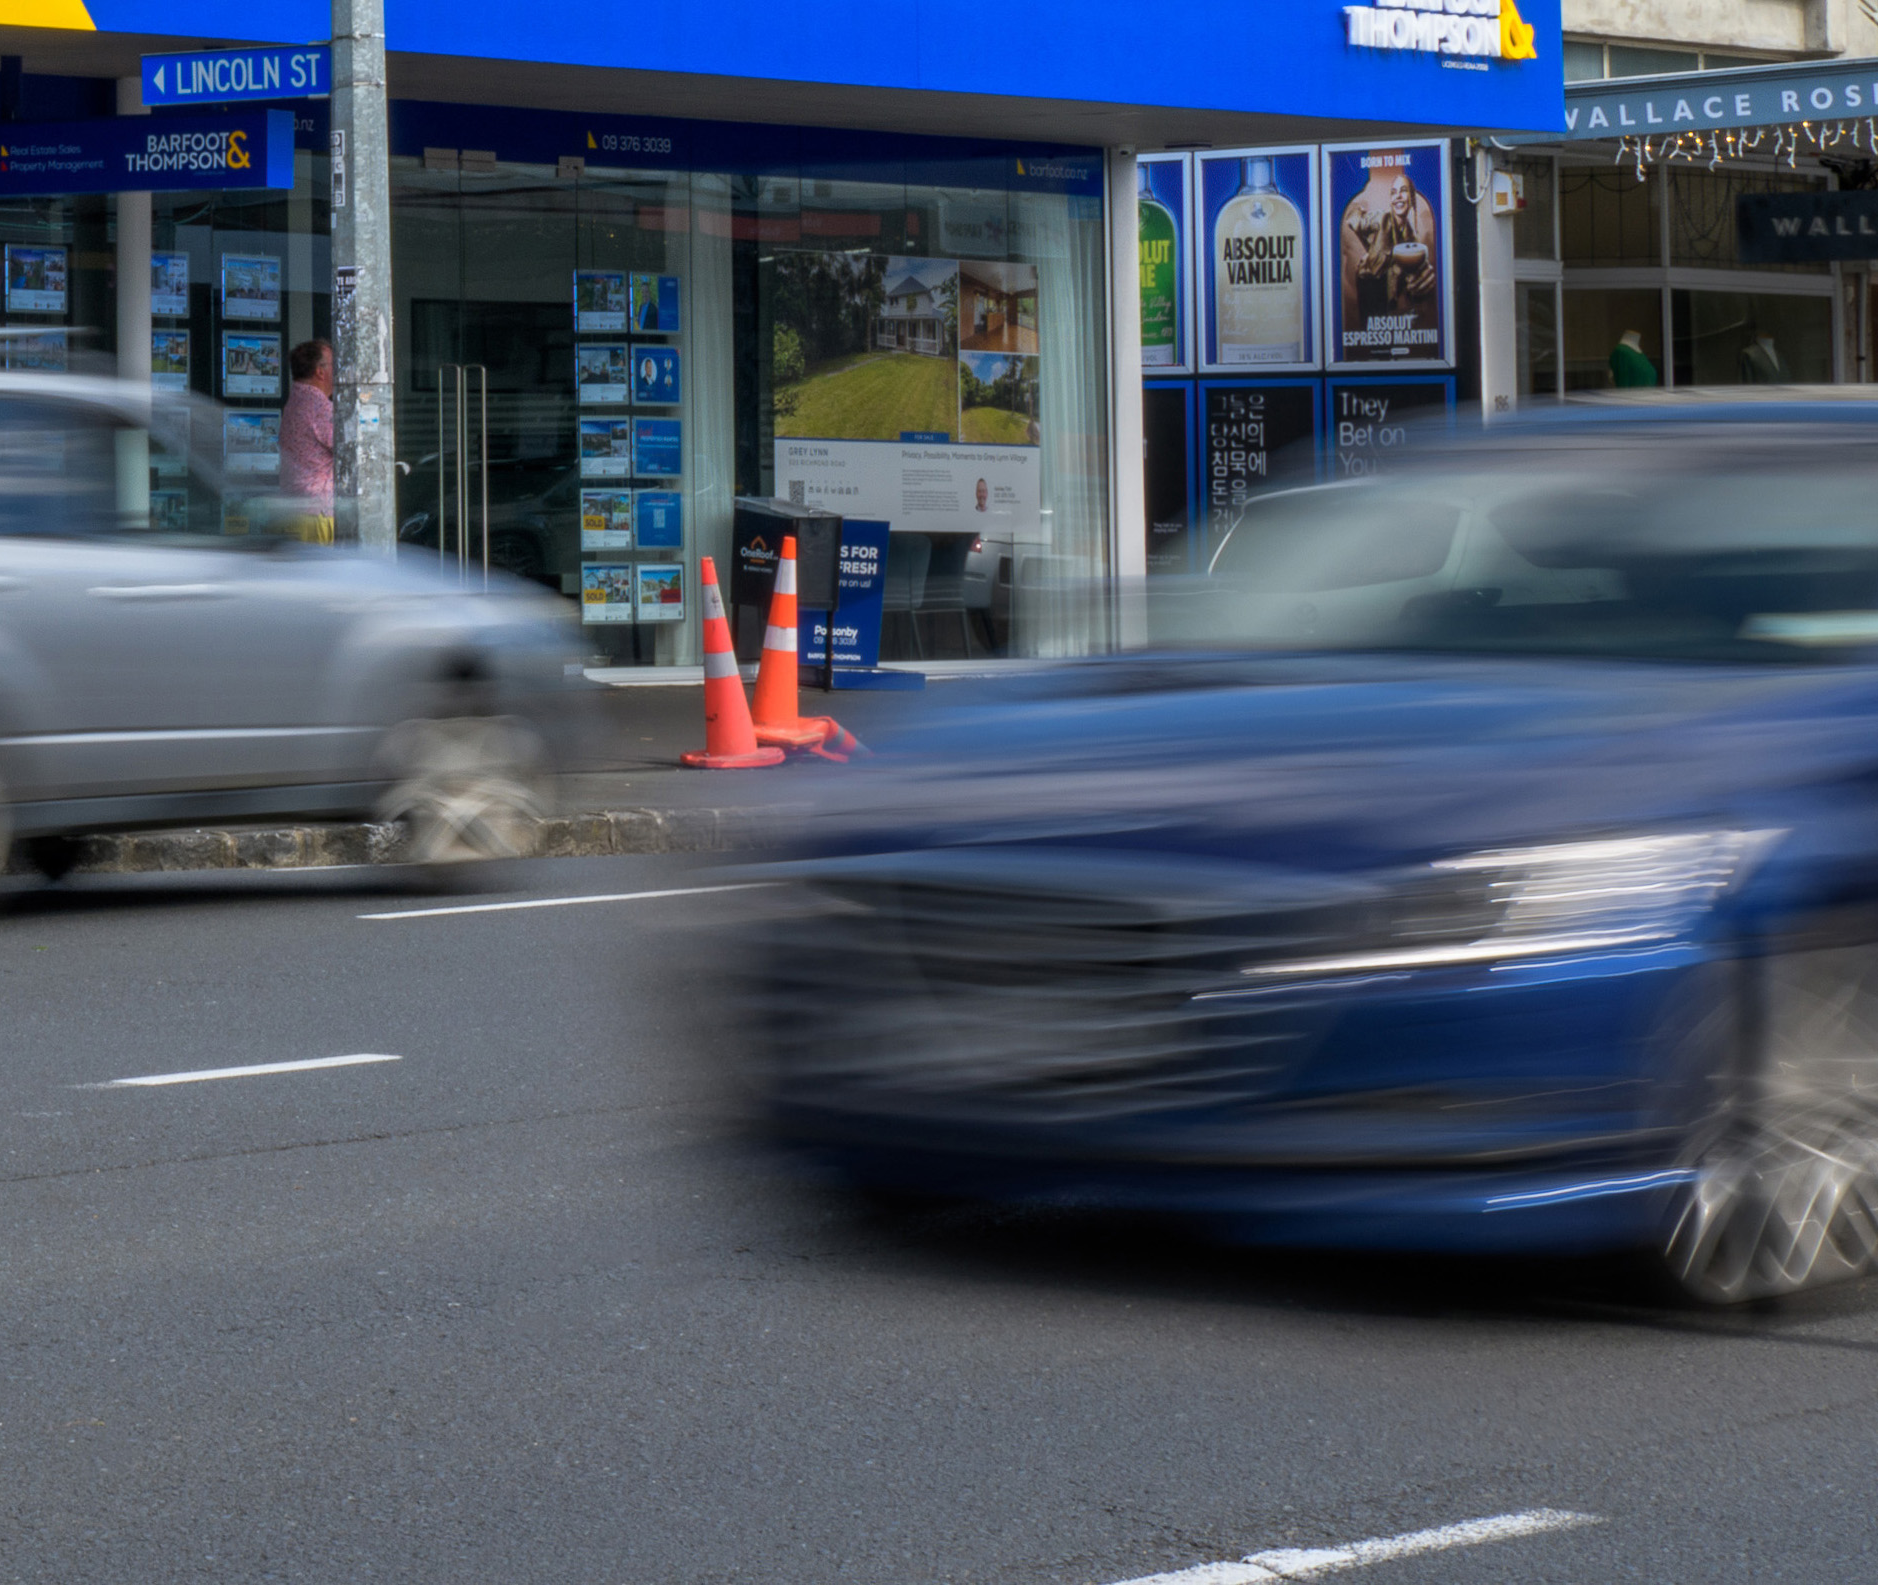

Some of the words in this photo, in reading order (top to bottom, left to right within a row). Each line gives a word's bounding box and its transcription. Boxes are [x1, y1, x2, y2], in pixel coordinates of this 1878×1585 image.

[1343, 5, 1501, 57] THOMPSON
[177, 56, 280, 95] LINCOLN
[290, 53, 321, 87] ST
[1781, 83, 1878, 113] ROS
[10, 146, 29, 156] Real
[30, 145, 57, 156] Estate
[58, 144, 82, 154] Sales
[148, 132, 229, 152] BARFOOT
[226, 130, 251, 169] &
[602, 135, 617, 151] 09
[620, 135, 640, 152] 376
[643, 136, 671, 153] 3039
[48, 160, 105, 173] Management
[125, 151, 226, 172] THOMPSON
[1361, 156, 1381, 168] BORN
[1383, 155, 1394, 167] TO
[1029, 164, 1088, 181] barfoot.co.nz
[1772, 214, 1878, 237] WALL
[1223, 235, 1296, 261] ABSOLUT
[1227, 260, 1293, 285] VANILIA
[1367, 316, 1413, 331] ABSOLUT
[1343, 331, 1392, 346] ESPRESSO
[1394, 329, 1438, 344] MARTINI
[1339, 392, 1389, 422] They
[1211, 422, 1265, 448] 당신의
[1340, 422, 1373, 447] Bet
[1380, 427, 1405, 446] on
[788, 447, 807, 456] GREY
[810, 448, 829, 457] LYNN
[1211, 450, 1267, 477] 침묵에
[851, 546, 878, 559] FOR
[848, 579, 859, 587] on
[814, 625, 858, 638] Posonby
